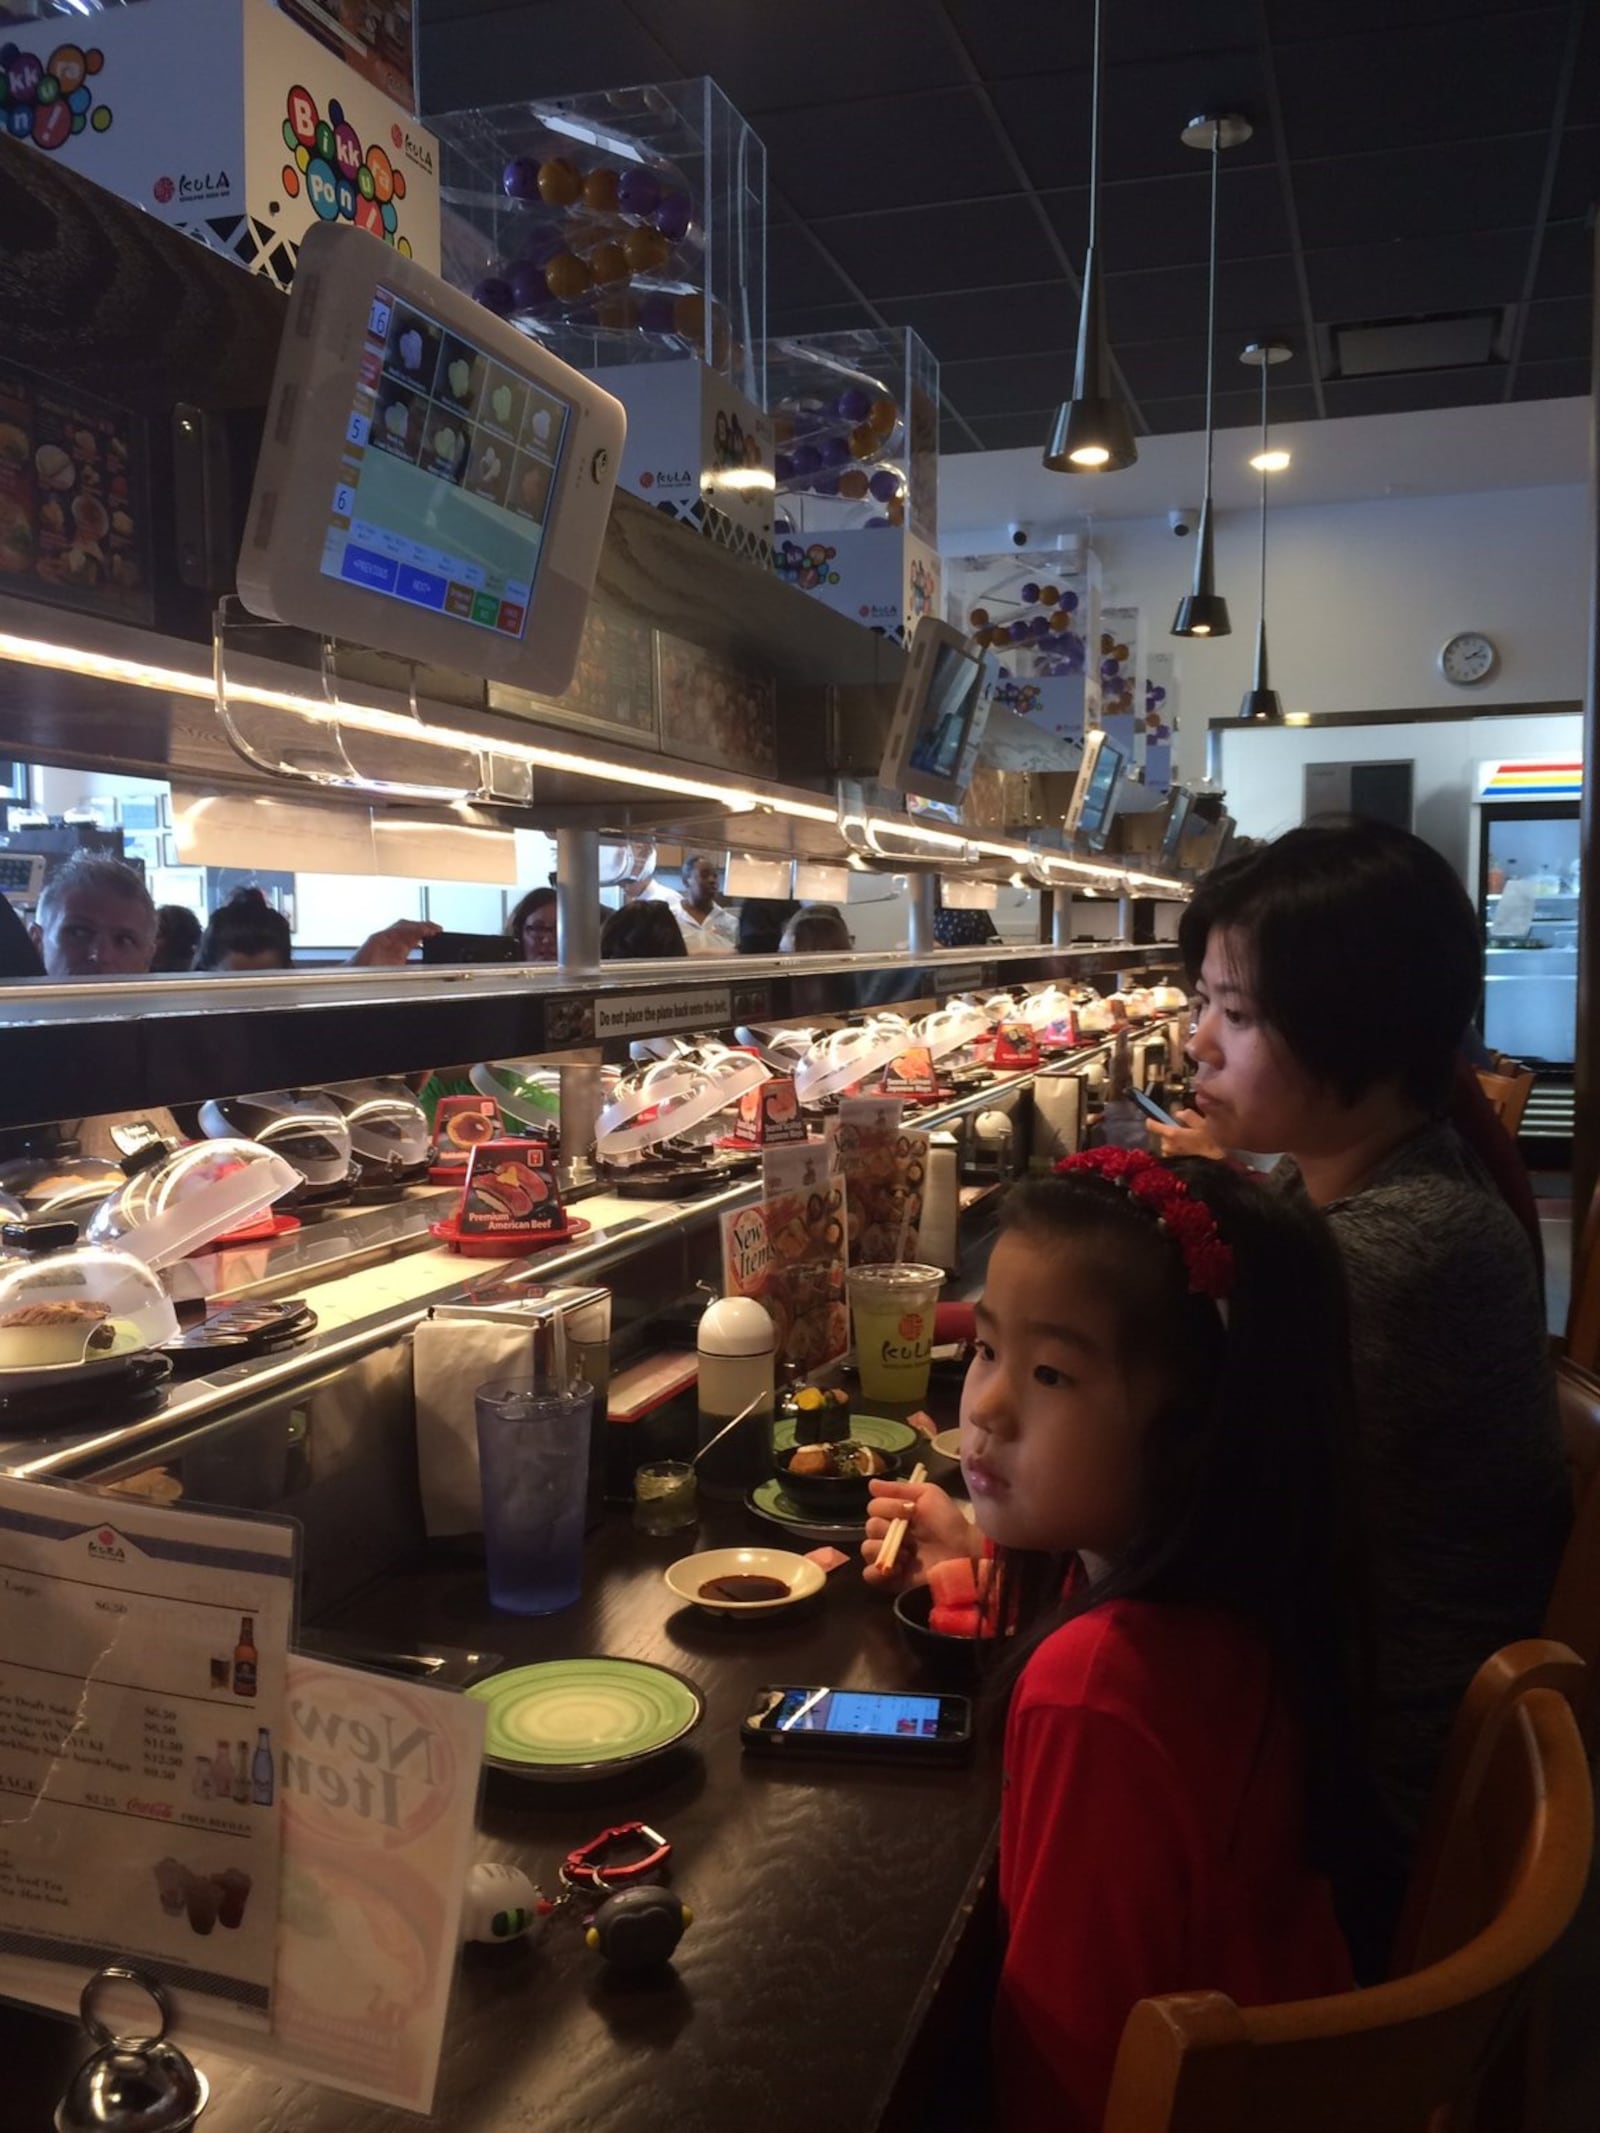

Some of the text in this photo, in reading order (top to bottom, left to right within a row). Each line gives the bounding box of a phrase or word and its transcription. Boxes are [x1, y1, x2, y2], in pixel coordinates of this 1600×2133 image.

[370, 306, 386, 334] 16
[351, 418, 361, 440] 5
[337, 490, 347, 511] 6
[600, 1010, 609, 1026] Do
[611, 1010, 624, 1025] not
[625, 1007, 643, 1027] place
[644, 1006, 656, 1022] the
[657, 1005, 673, 1023] plate
[674, 1002, 688, 1017] back
[704, 1001, 714, 1013] the
[469, 1212, 509, 1222] Premium
[488, 1219, 552, 1230] American Beef
[734, 1222, 762, 1250] New
